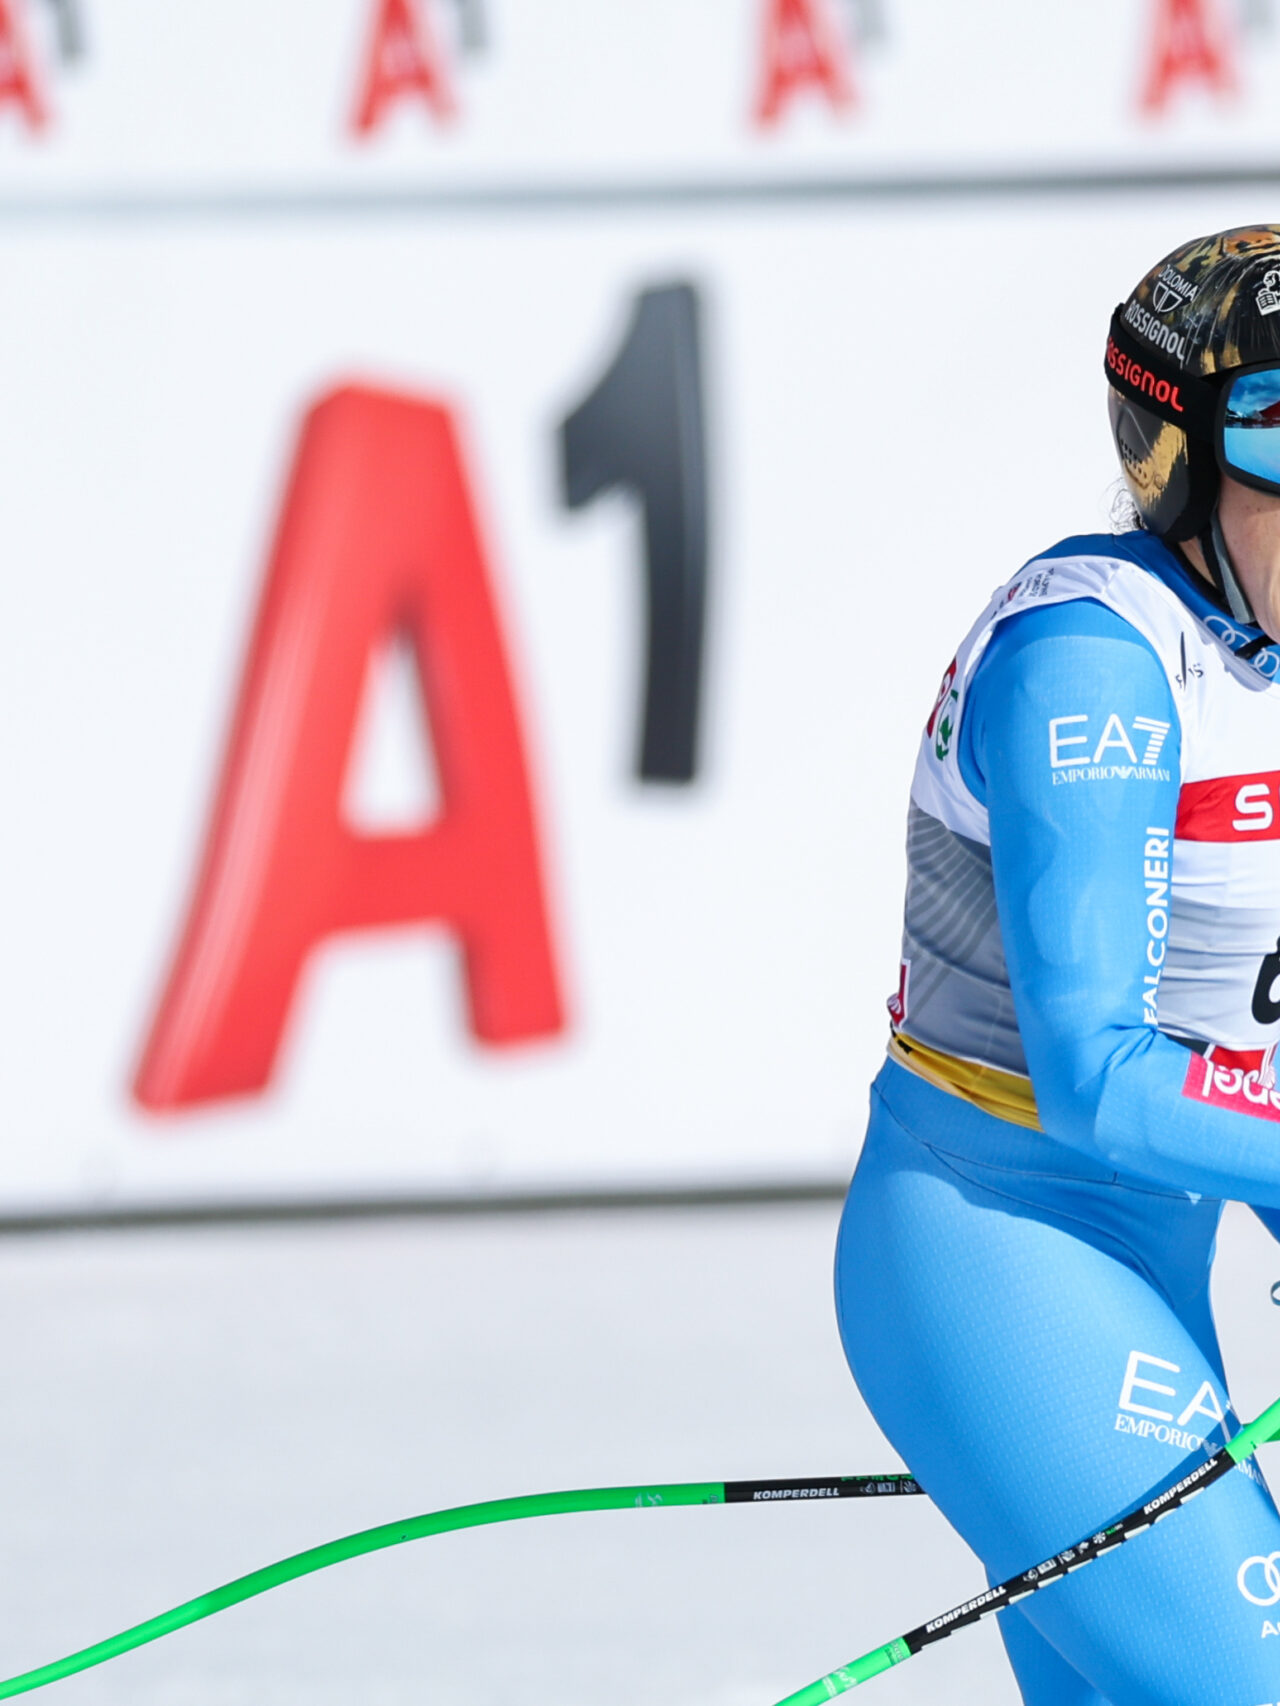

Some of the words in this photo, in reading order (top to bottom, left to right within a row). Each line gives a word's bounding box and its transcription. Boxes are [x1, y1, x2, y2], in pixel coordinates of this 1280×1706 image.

[1124, 299, 1185, 360] ROSSIGNOL
[132, 280, 707, 1114] A1
[1048, 713, 1171, 769] EA7
[1051, 766, 1114, 785] EMPORIO
[1143, 826, 1170, 1025] FALCONERI
[1113, 1413, 1203, 1453] EMPORIO
[753, 1486, 840, 1501] KOMPERDELL
[1142, 1457, 1219, 1515] KOMPERDELL
[925, 1585, 1007, 1634] KOMPERDELL
